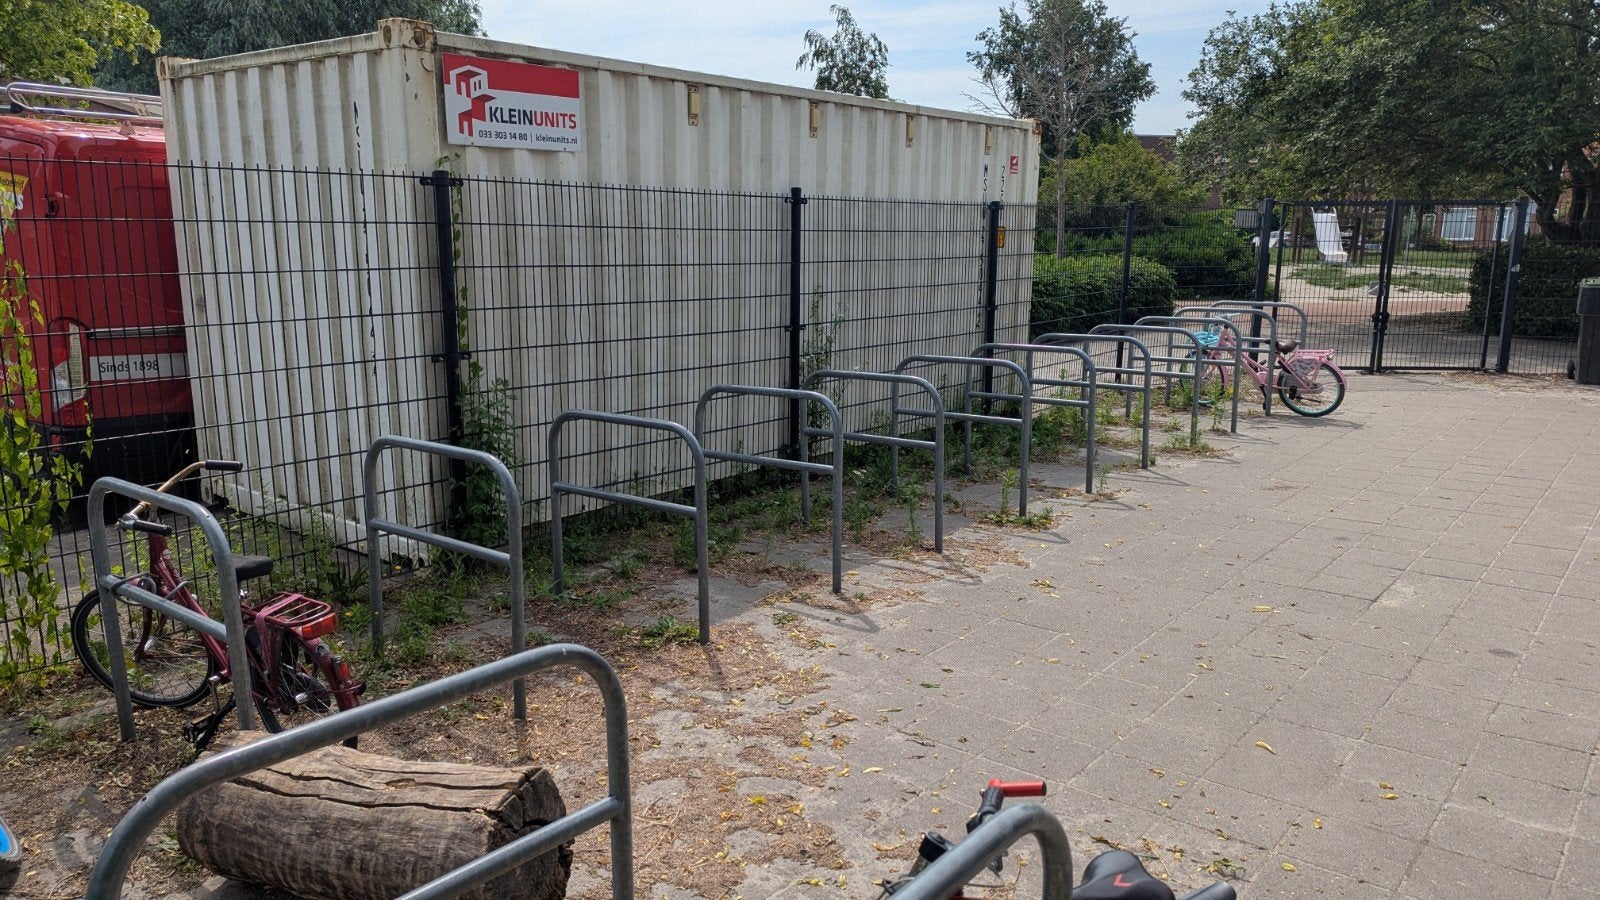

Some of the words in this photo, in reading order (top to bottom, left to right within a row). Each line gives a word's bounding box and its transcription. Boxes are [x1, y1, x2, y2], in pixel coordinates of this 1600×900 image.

[489, 106, 576, 129] KLEINUNITS
[478, 130, 492, 138] 033
[494, 131, 507, 139] 303
[508, 132, 517, 140] 14
[518, 133, 528, 141] 80
[535, 134, 578, 144] kleinunits.nl
[100, 361, 130, 373] Sinds
[132, 361, 159, 371] 1898
